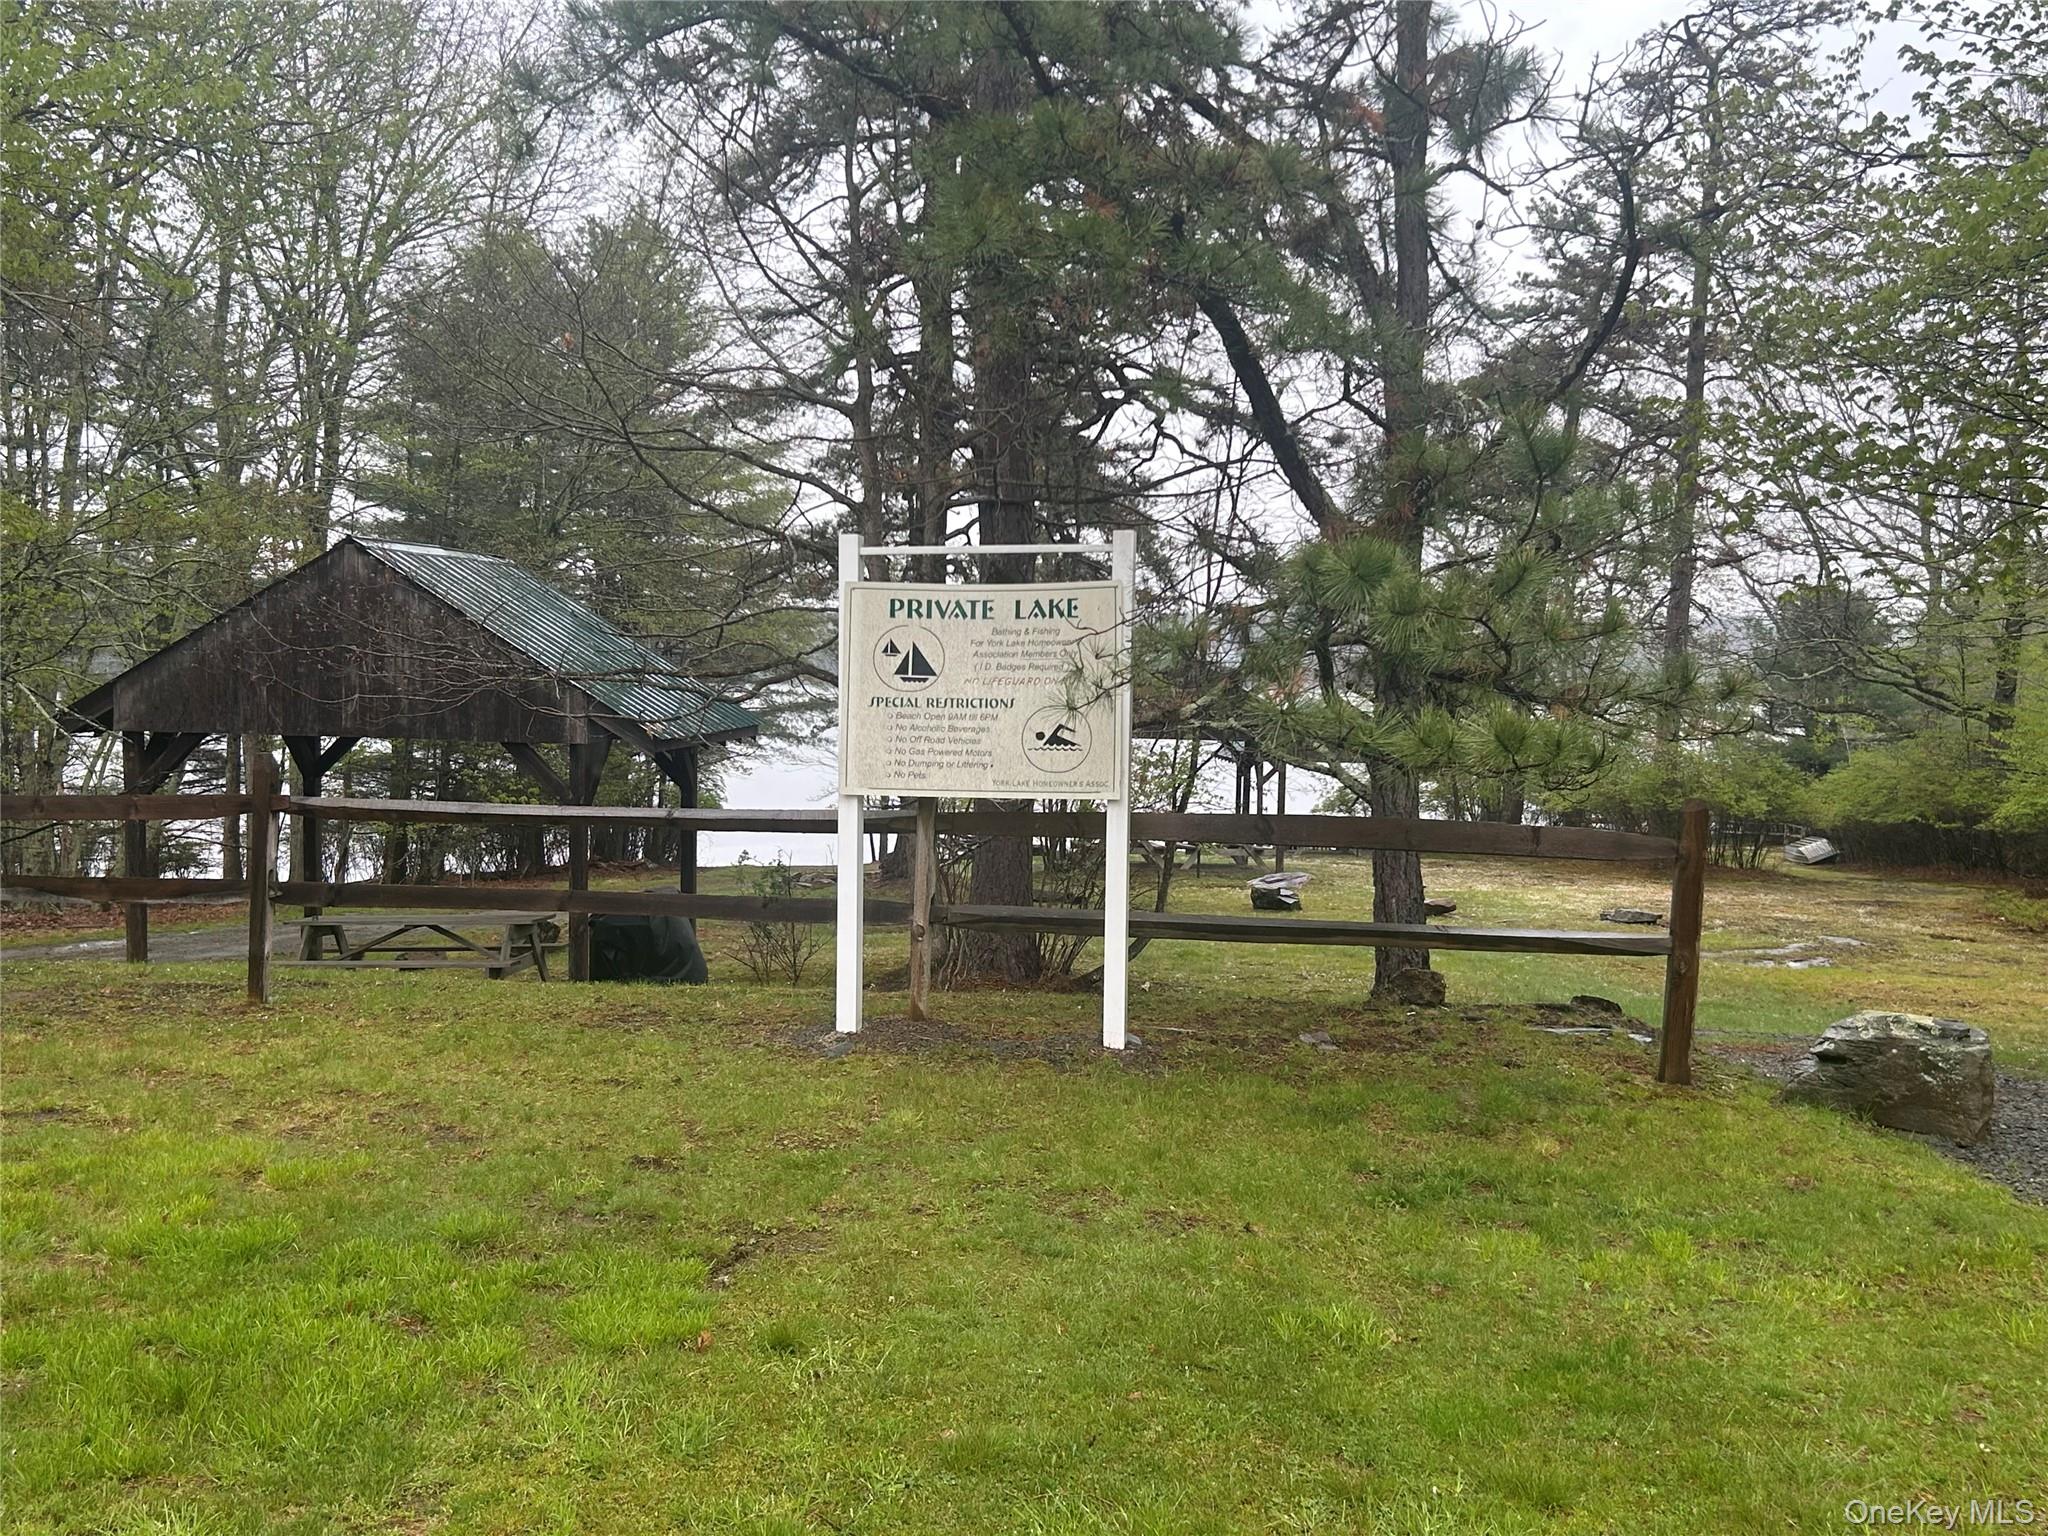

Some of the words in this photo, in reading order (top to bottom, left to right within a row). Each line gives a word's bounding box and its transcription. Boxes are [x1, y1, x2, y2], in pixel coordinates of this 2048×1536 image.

[889, 598, 995, 620] PRIVATE
[1015, 598, 1080, 619] LAKE
[991, 627, 1021, 636] Bathing
[1023, 627, 1030, 636] &
[1032, 627, 1061, 636] Fishing
[970, 639, 984, 648] For
[987, 639, 1003, 648] York
[1006, 639, 1025, 648] Lake
[973, 650, 1019, 659] Association
[1020, 649, 1058, 658] Members
[996, 662, 1026, 672] Badges
[982, 676, 1041, 687] LIFEGUARD
[868, 696, 921, 709] SPECIAL
[926, 697, 1015, 710] RESTRICTIONS
[895, 711, 921, 720] Beach
[924, 712, 945, 721] Open
[980, 713, 998, 721] 6PM
[895, 723, 907, 731] No
[909, 723, 946, 733] Alcoholic
[947, 724, 990, 735] Beverages
[895, 735, 907, 743] No
[909, 735, 923, 744] Off
[923, 736, 945, 744] Road
[947, 736, 982, 745] Vehicles
[894, 747, 906, 756] No
[908, 747, 925, 756] Gas
[927, 748, 963, 757] Powered
[964, 749, 993, 757] Motors
[894, 759, 906, 767] No
[908, 759, 944, 769] Dumping
[956, 761, 989, 771] Littering
[893, 771, 906, 779] No
[907, 771, 926, 780] Pets
